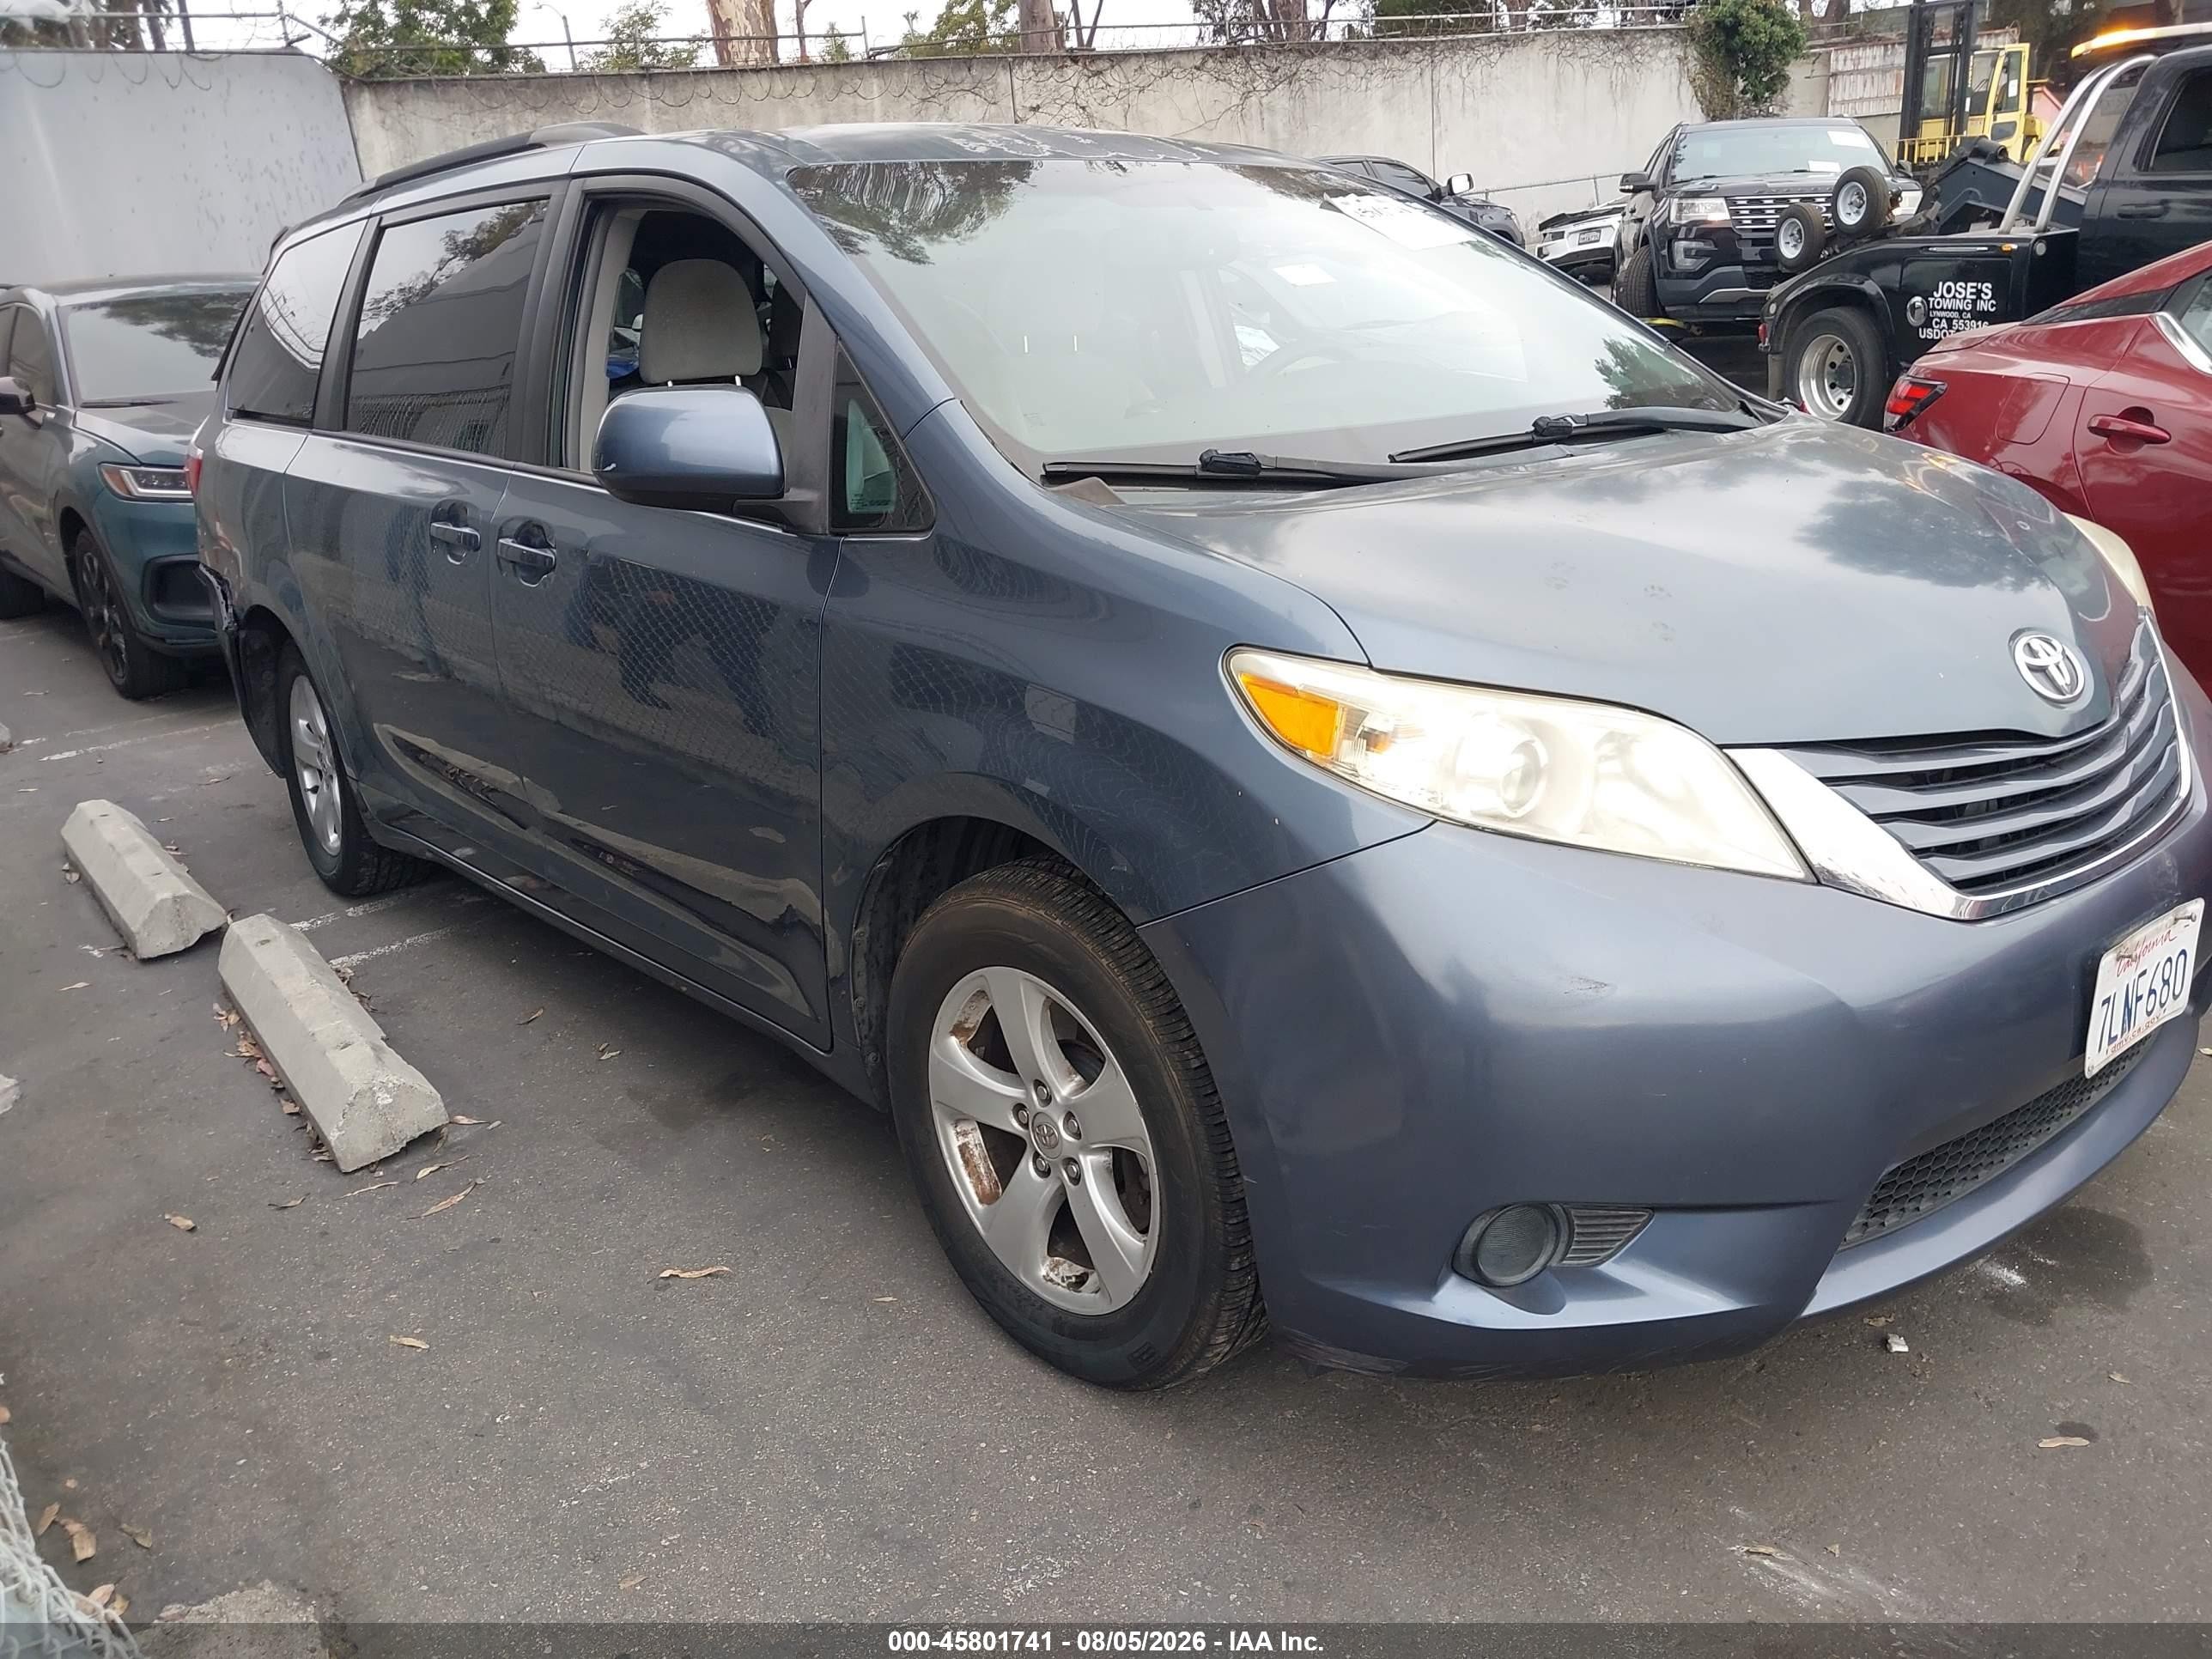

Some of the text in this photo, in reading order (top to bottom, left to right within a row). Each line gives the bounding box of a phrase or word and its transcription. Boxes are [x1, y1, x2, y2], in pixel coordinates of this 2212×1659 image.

[1933, 282, 1992, 300] JOSE'S
[1928, 297, 1996, 312] TOWING INC
[1929, 310, 1960, 319] LYNWOOD,
[1932, 318, 1948, 329] CA
[2098, 948, 2187, 1054] 7LNF680
[2111, 1012, 2161, 1054] dmv.ca.gov
